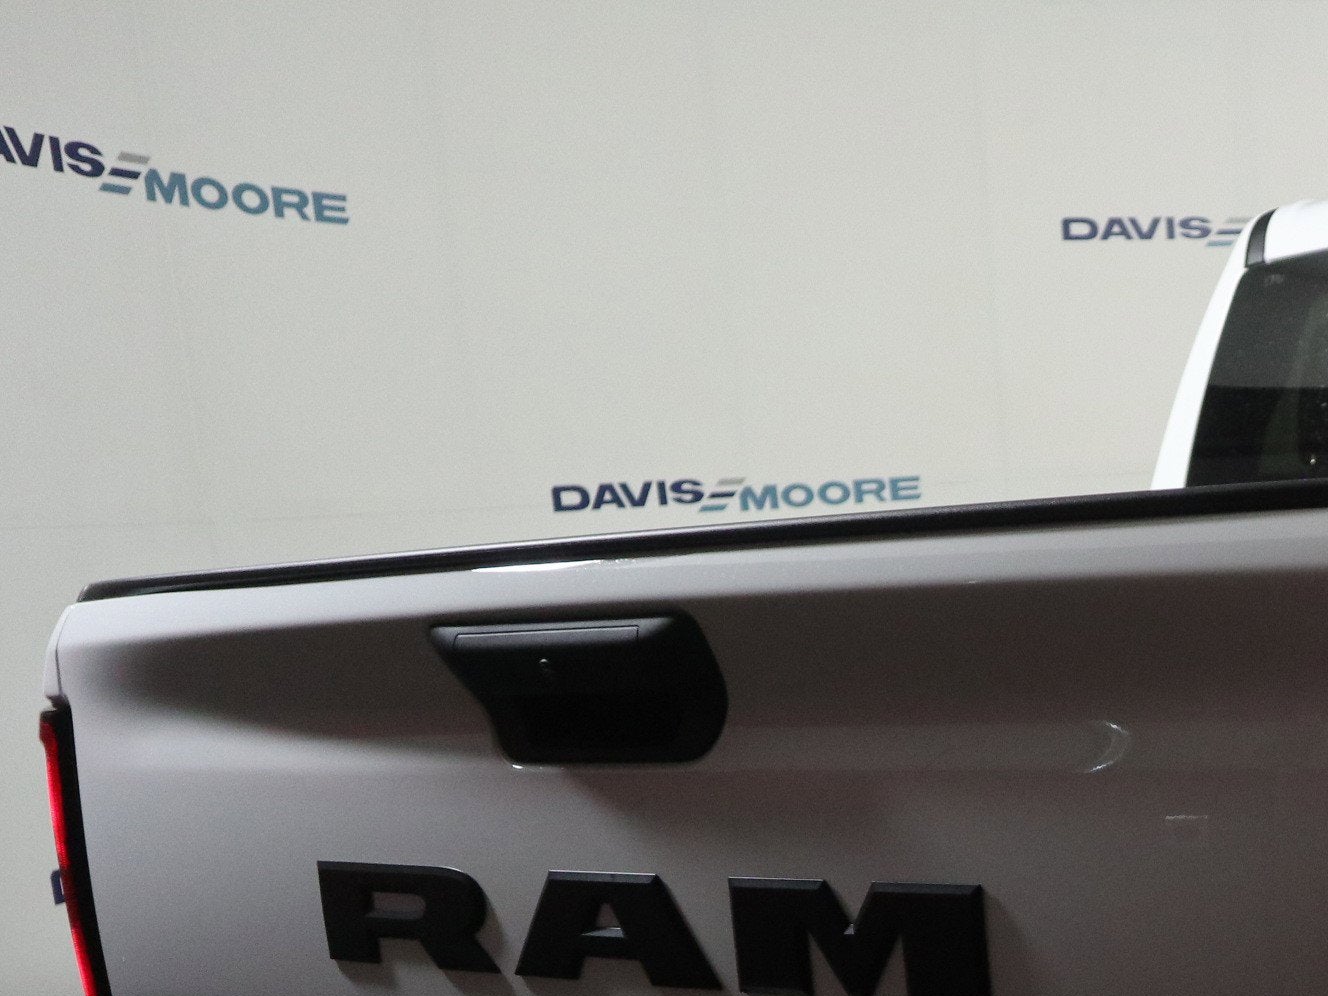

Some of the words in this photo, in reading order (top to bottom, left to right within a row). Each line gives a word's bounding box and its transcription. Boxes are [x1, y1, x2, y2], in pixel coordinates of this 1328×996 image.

[144, 167, 348, 225] MOORE
[1061, 216, 1211, 241] DAVIS
[551, 479, 704, 512] DAVIS
[738, 475, 922, 512] MOORE
